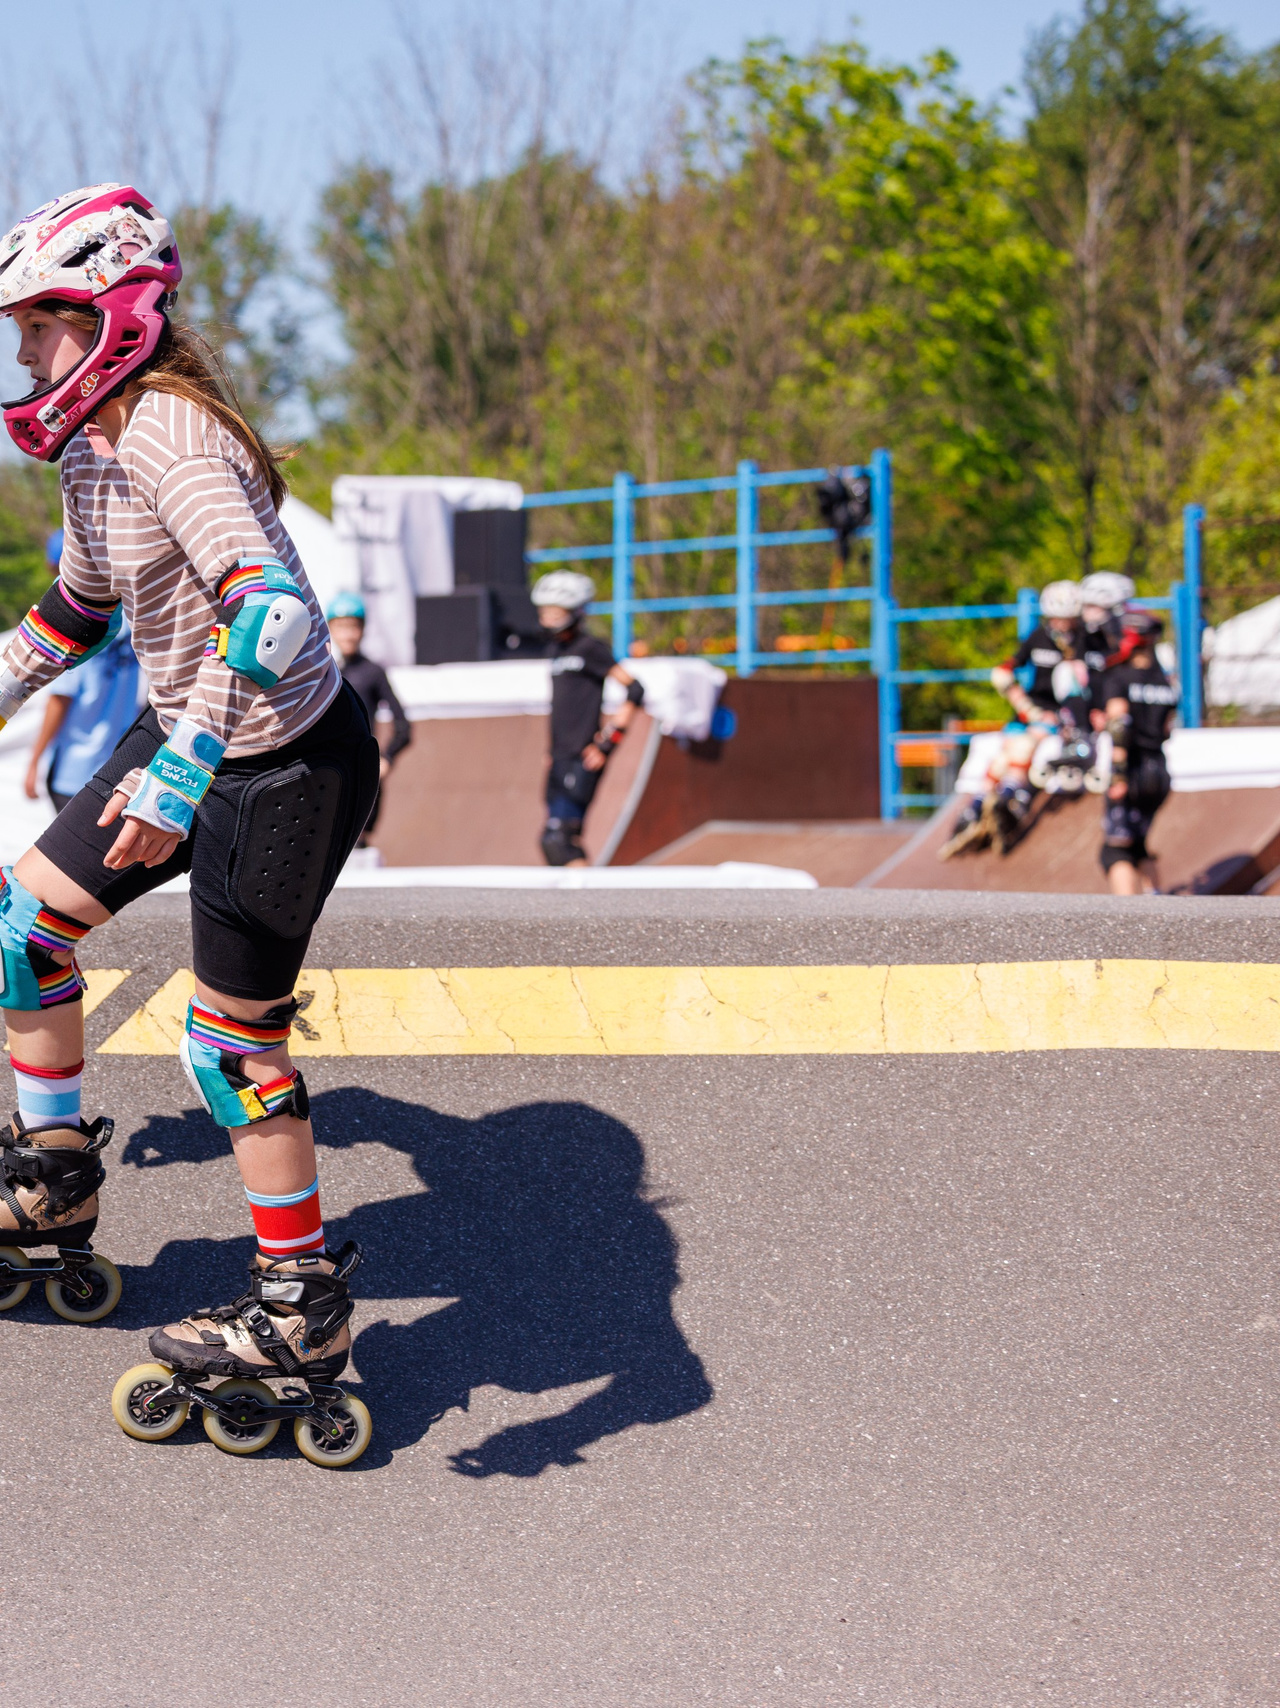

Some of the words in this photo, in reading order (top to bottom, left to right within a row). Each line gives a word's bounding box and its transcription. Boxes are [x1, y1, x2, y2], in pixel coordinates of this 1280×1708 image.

[53, 407, 81, 438] JCAT
[155, 758, 189, 777] EAGLE
[160, 769, 199, 788] FLYING
[189, 1391, 220, 1411] VALOR
